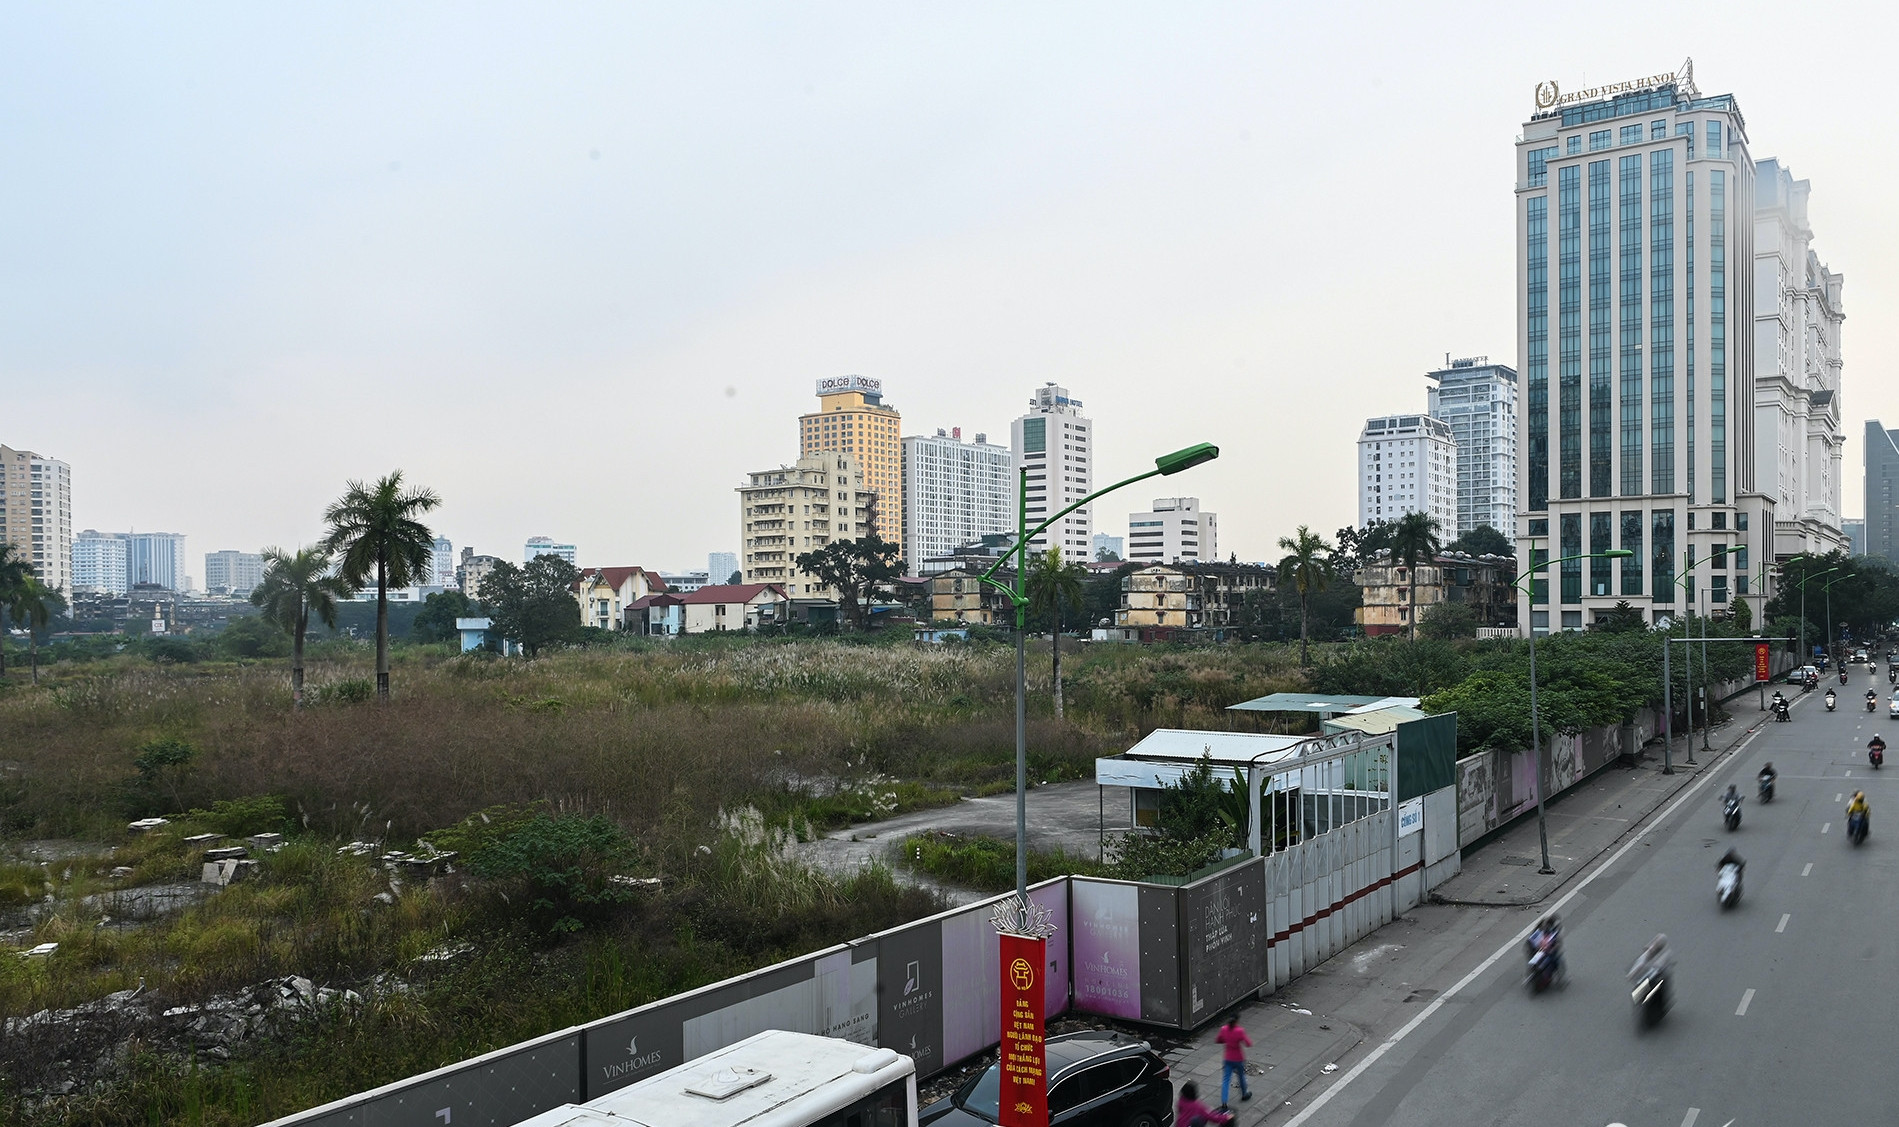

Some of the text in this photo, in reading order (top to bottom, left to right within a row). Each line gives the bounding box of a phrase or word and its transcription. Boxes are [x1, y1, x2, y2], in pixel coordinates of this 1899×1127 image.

[1560, 72, 1676, 103] GRAND VISTA HANOI
[1084, 961, 1128, 976] VINHOMES
[893, 990, 933, 1011] VINHOMES
[899, 1001, 928, 1018] GALLERY
[853, 1013, 870, 1025] SANG
[1023, 1023, 1034, 1031] NAM
[603, 1050, 661, 1079] VINHOMES
